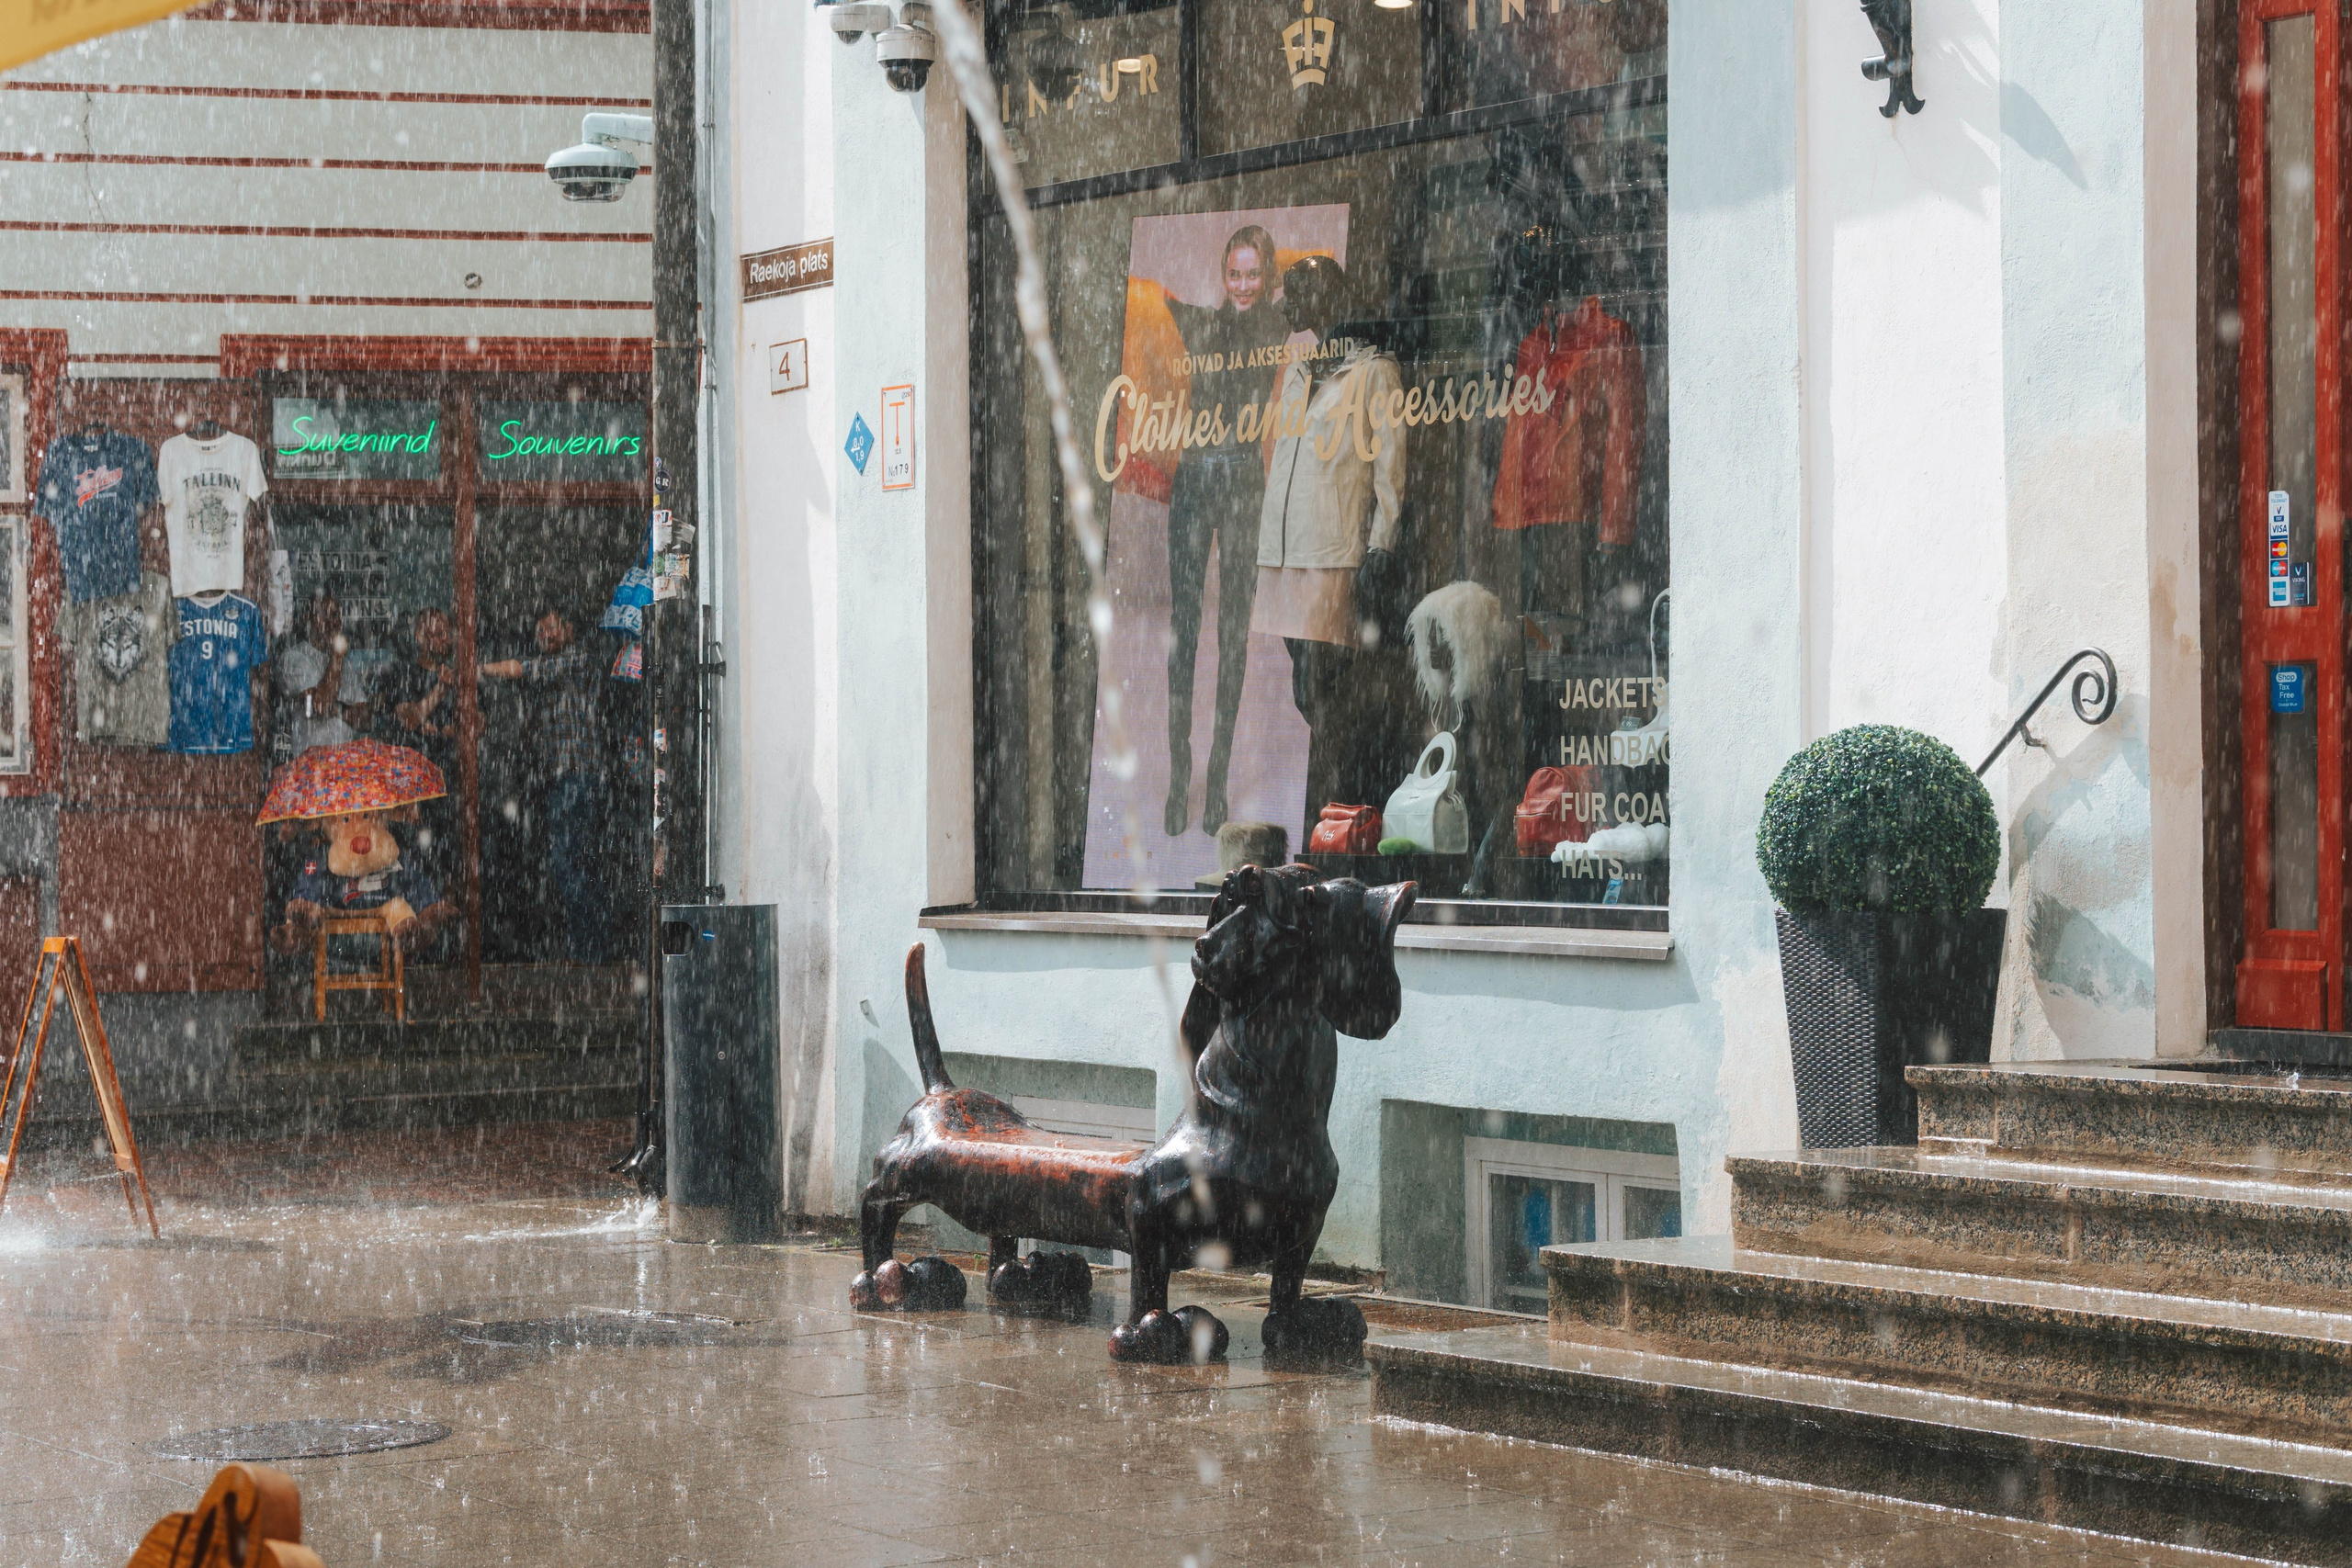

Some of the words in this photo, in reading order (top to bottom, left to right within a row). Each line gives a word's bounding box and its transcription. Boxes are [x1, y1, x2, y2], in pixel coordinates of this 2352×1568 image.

[750, 255, 797, 284] Raekoja
[799, 248, 829, 278] plats
[778, 351, 790, 380] 4
[1172, 350, 1224, 378] RÕIVAD
[1227, 350, 1245, 369] JA
[1247, 336, 1355, 368] AKSESSUAARID
[855, 421, 861, 433] K
[1094, 374, 1232, 483] Clothes
[1237, 374, 1314, 446] and
[1313, 344, 1556, 462] Accessories
[278, 416, 436, 456] Suveniirid
[488, 420, 641, 459] Souvenirs
[183, 471, 241, 493] TALLINN
[2271, 525, 2288, 533] VISA
[201, 641, 214, 660] 9
[1559, 676, 1668, 709] JACKETS
[2278, 673, 2296, 682] Shop
[2278, 691, 2295, 699] Free
[1561, 792, 1608, 823] FUR
[1613, 792, 1669, 823] COA
[1561, 849, 1642, 880] HATS...
